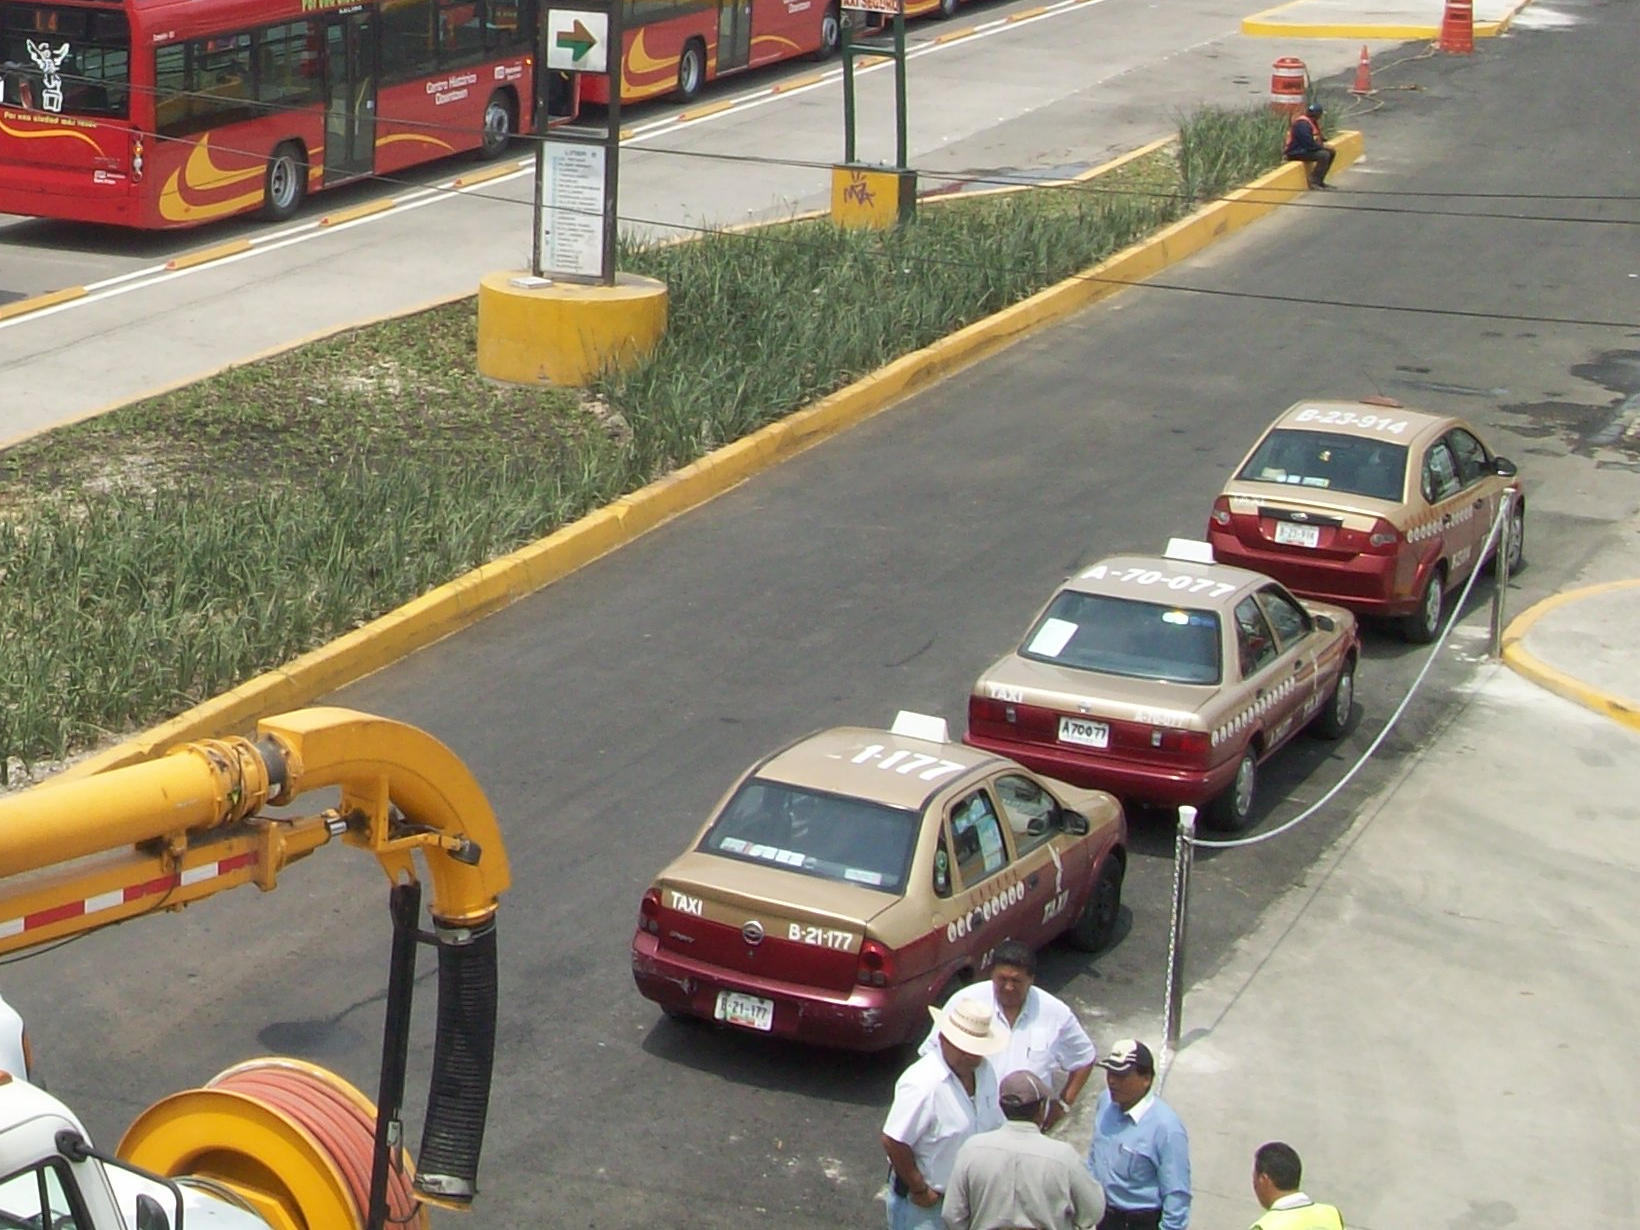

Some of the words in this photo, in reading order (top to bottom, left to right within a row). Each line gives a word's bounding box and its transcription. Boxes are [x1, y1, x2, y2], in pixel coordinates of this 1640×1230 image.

[1294, 409, 1408, 434] B-23-914
[1081, 565, 1236, 597] A-70-077
[991, 687, 1024, 703] TAXI
[1061, 722, 1106, 739] A70077
[826, 744, 966, 781] 1-177
[670, 891, 703, 915] TAXI
[788, 923, 853, 951] B-21-177
[721, 996, 768, 1020] B-21-177
